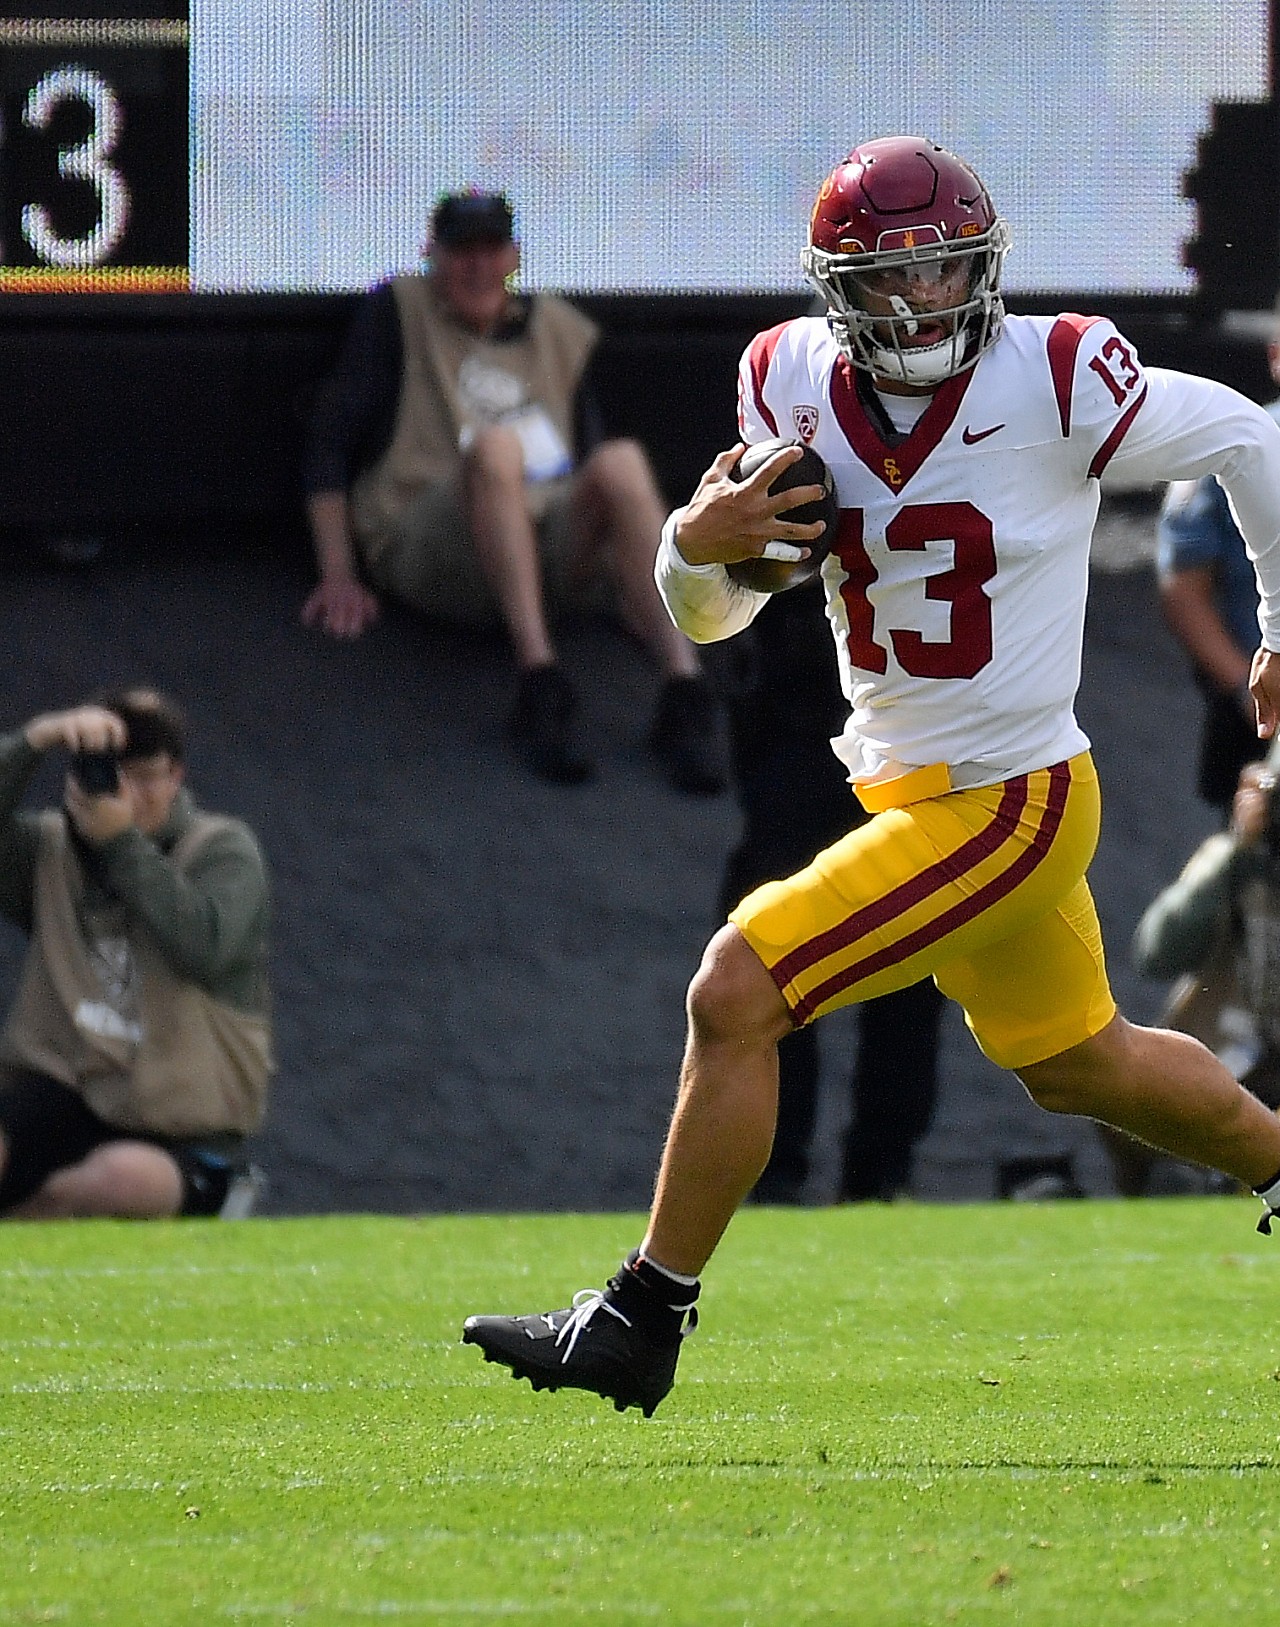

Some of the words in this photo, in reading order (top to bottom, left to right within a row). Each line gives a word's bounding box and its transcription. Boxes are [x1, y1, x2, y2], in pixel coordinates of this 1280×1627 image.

[21, 62, 132, 268] 3
[962, 224, 979, 236] USC
[1088, 336, 1140, 407] 13
[883, 458, 902, 485] SC
[832, 501, 998, 680] 13
